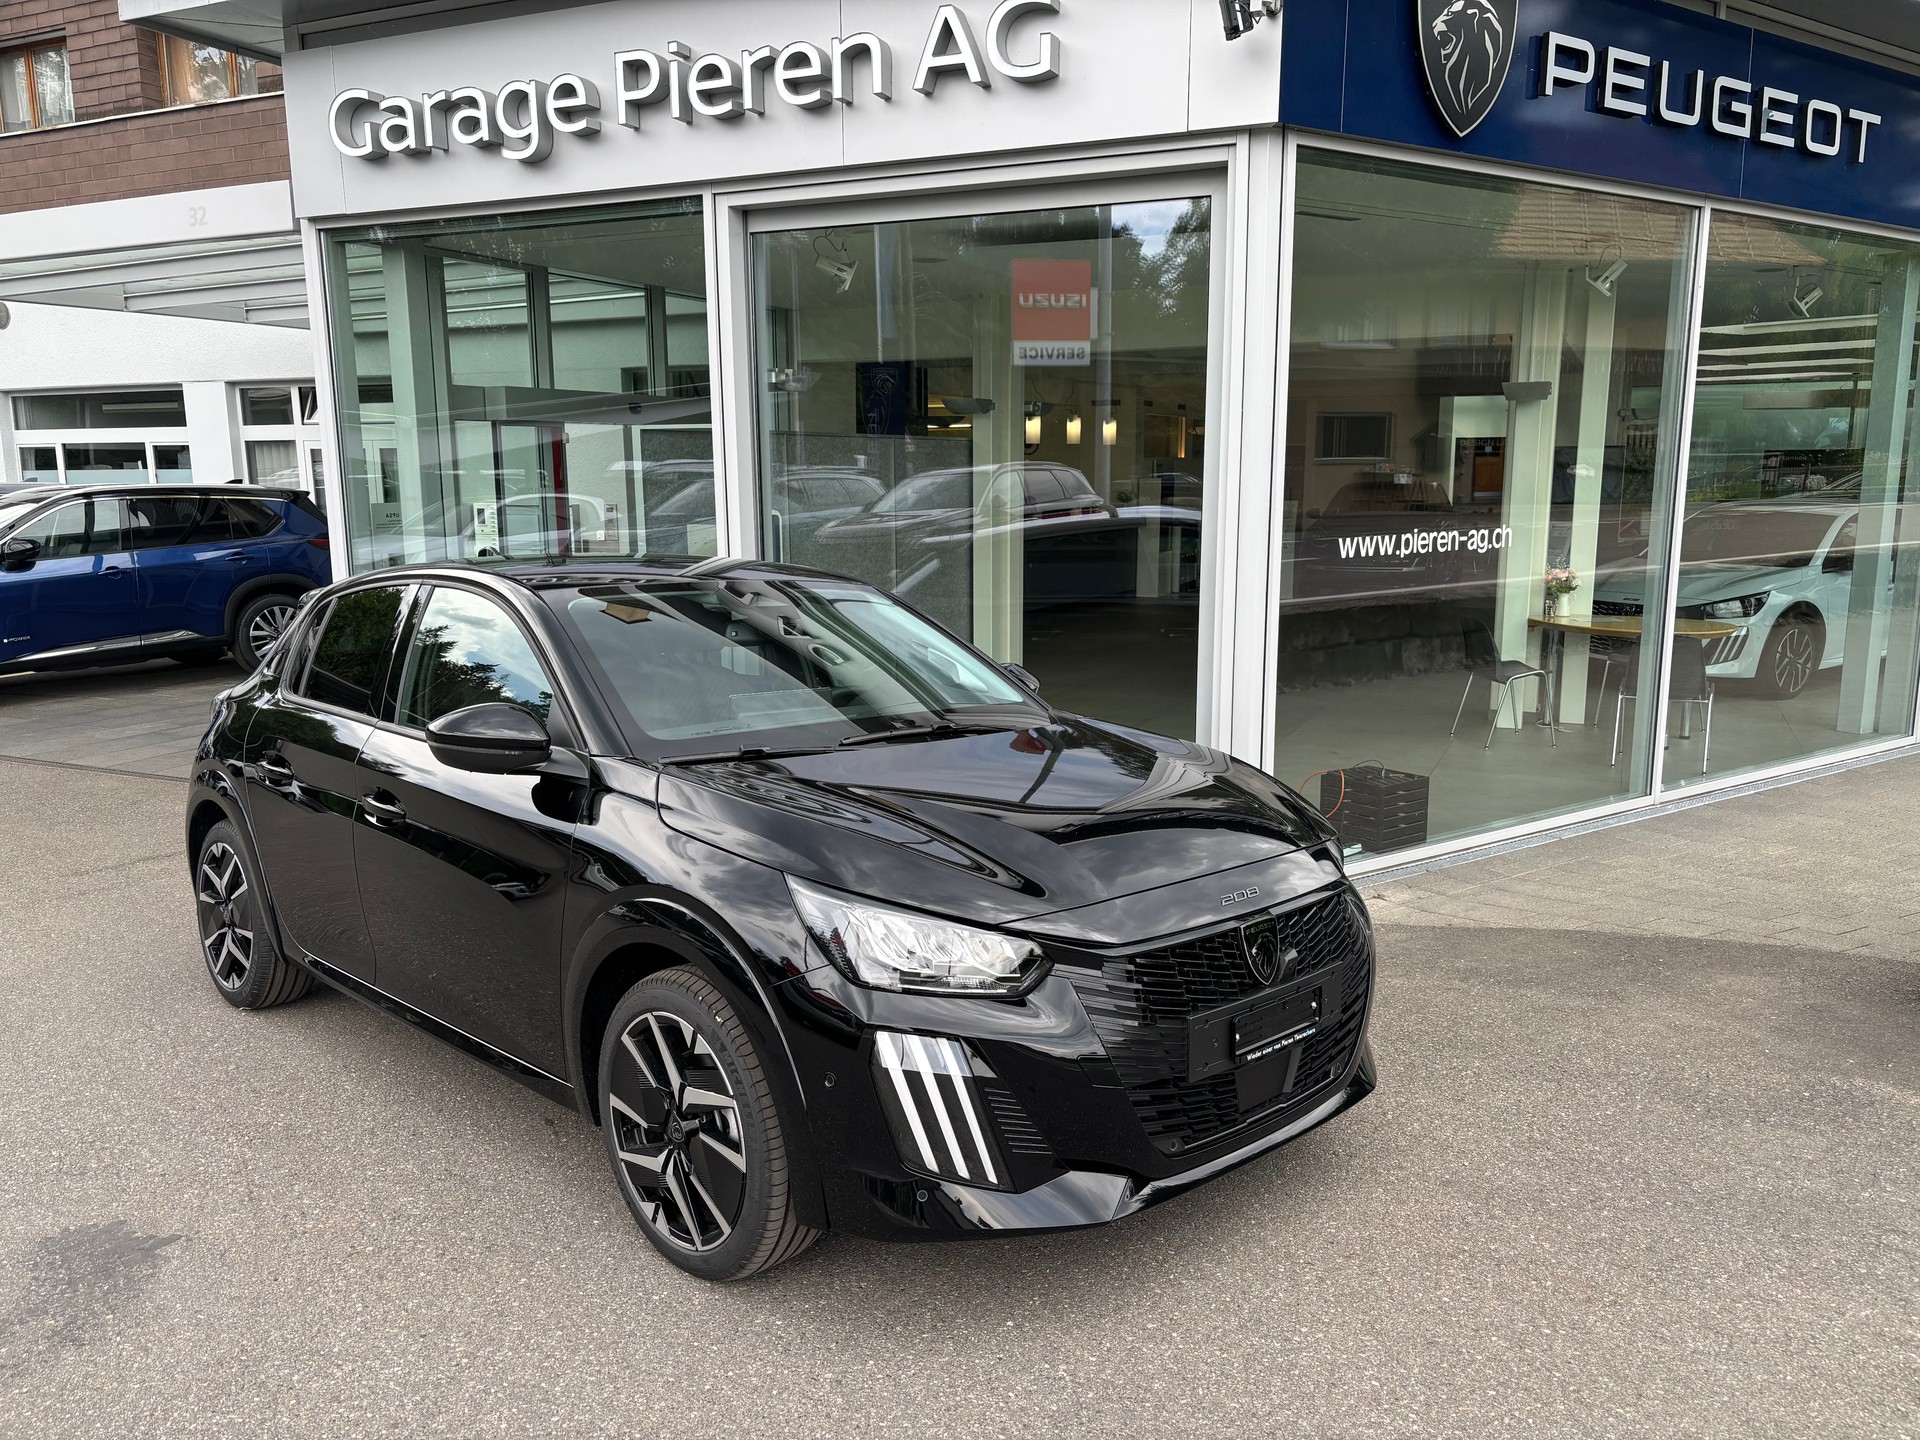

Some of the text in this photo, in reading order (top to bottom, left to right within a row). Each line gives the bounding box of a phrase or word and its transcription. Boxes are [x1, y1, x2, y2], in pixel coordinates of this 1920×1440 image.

[328, 0, 1060, 163] Garage Pieren AG
[1540, 30, 1882, 164] PEUGEOT
[189, 206, 208, 227] 32
[1338, 524, 1513, 559] www.pieren-ag.ch
[1220, 886, 1260, 906] 208
